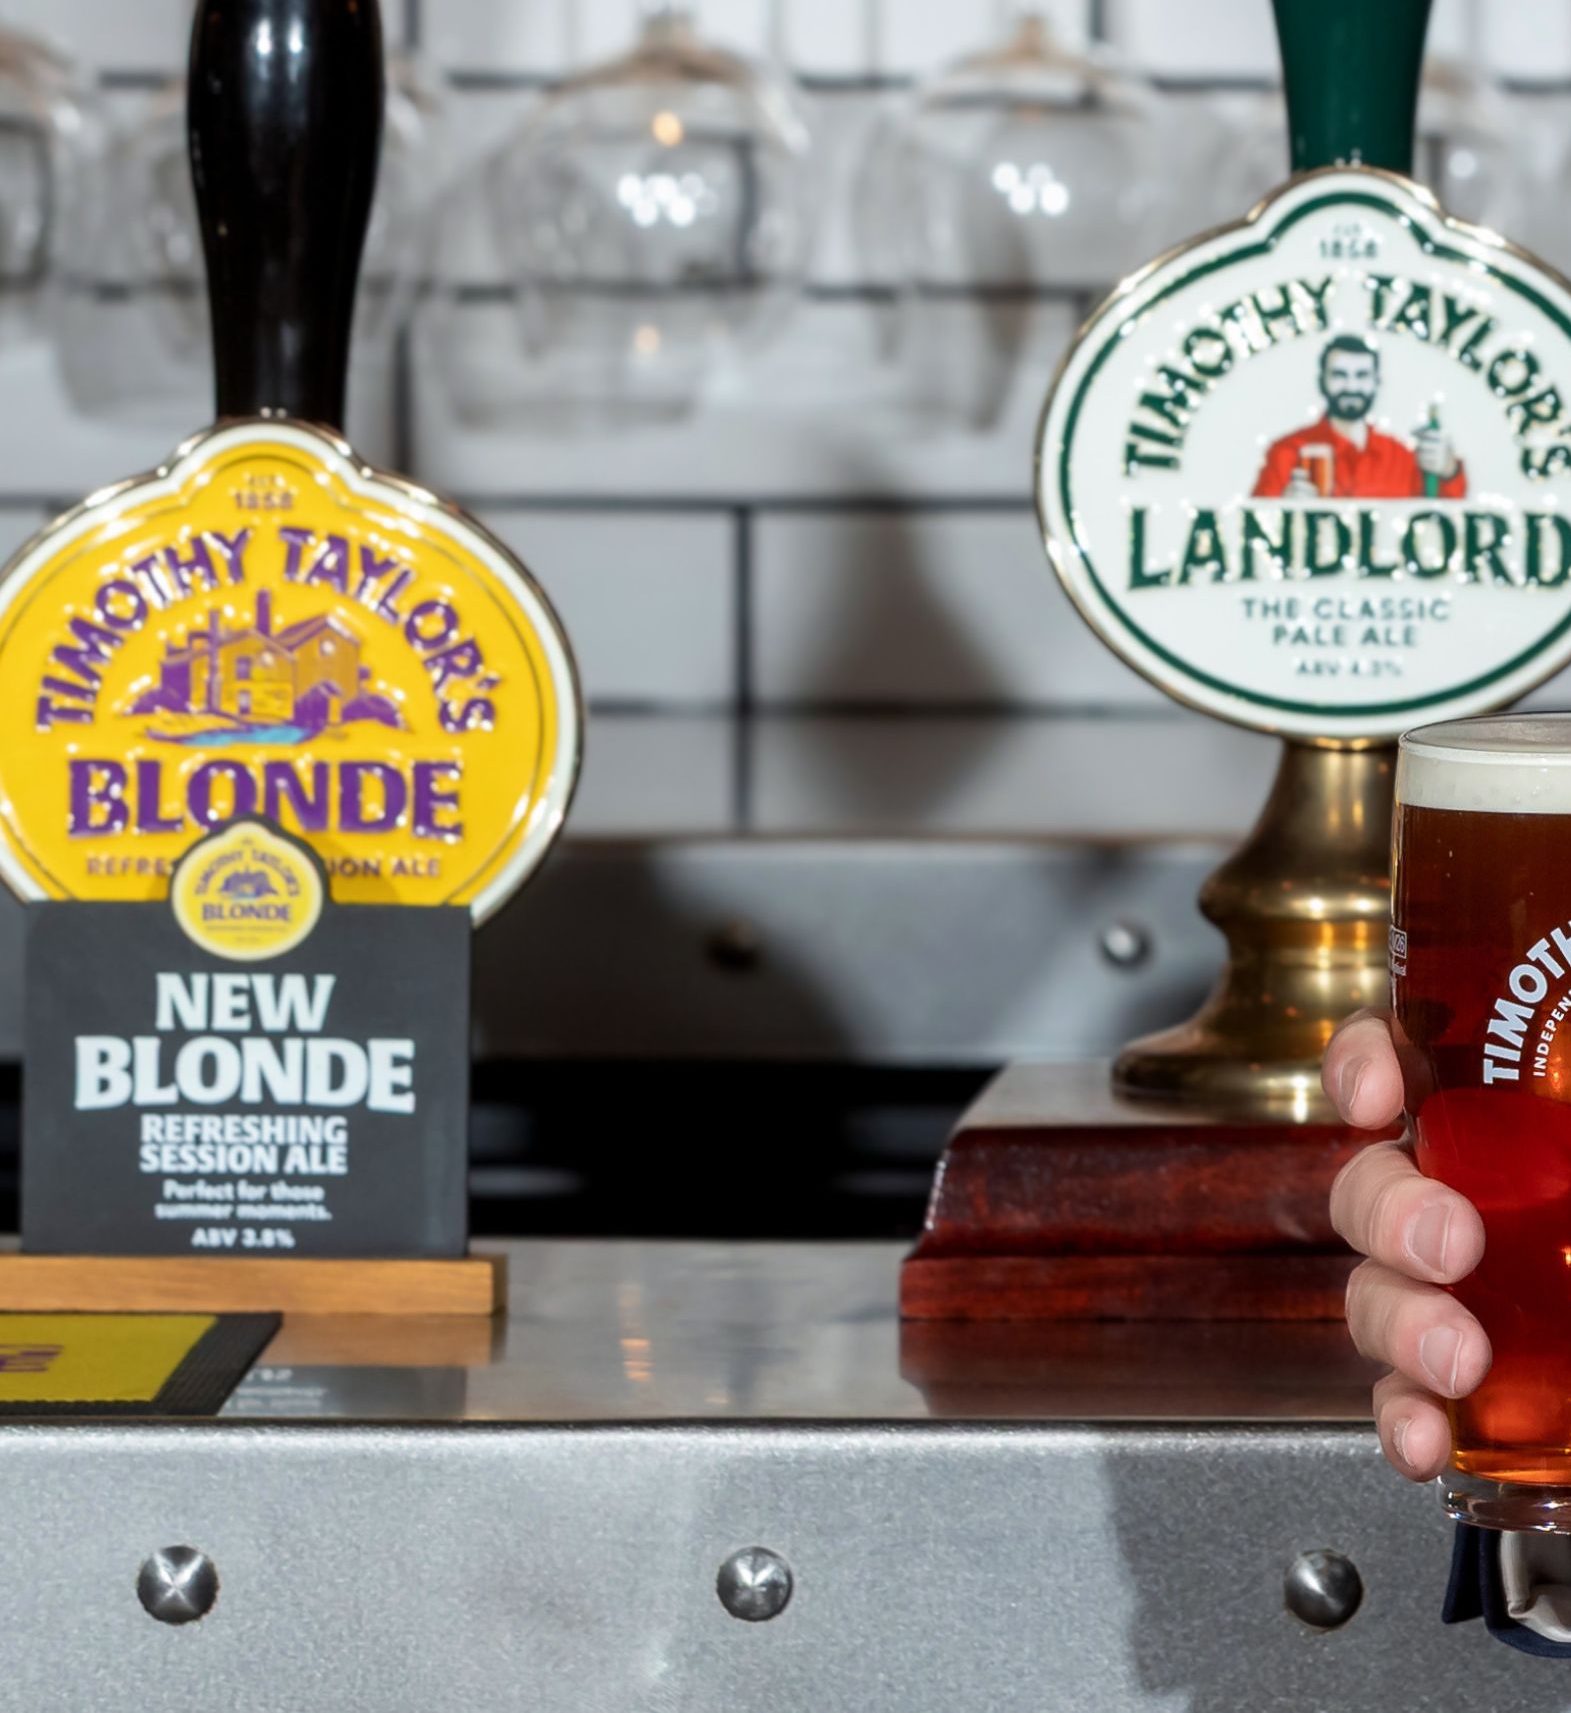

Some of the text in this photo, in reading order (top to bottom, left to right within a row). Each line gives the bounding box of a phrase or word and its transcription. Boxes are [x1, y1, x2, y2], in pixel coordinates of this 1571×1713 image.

[1123, 276, 1336, 477] TIMOTHY
[1243, 598, 1450, 620] THE CLASSIC
[36, 526, 501, 734] TIMOTHY TAYLOR'S
[1273, 625, 1417, 646] PALE ALE
[68, 760, 464, 838] BLONDE
[392, 856, 441, 878] ALE
[202, 902, 291, 922] BLONDE
[156, 973, 336, 1031] NEW
[74, 1035, 416, 1113] BLONDE
[140, 1114, 348, 1146] REFRESHING
[139, 1143, 348, 1175] SESSION ALE
[163, 1179, 325, 1202] Perfect for those
[154, 1202, 333, 1221] summer moments.
[191, 1227, 296, 1249] ABV 3.8%
